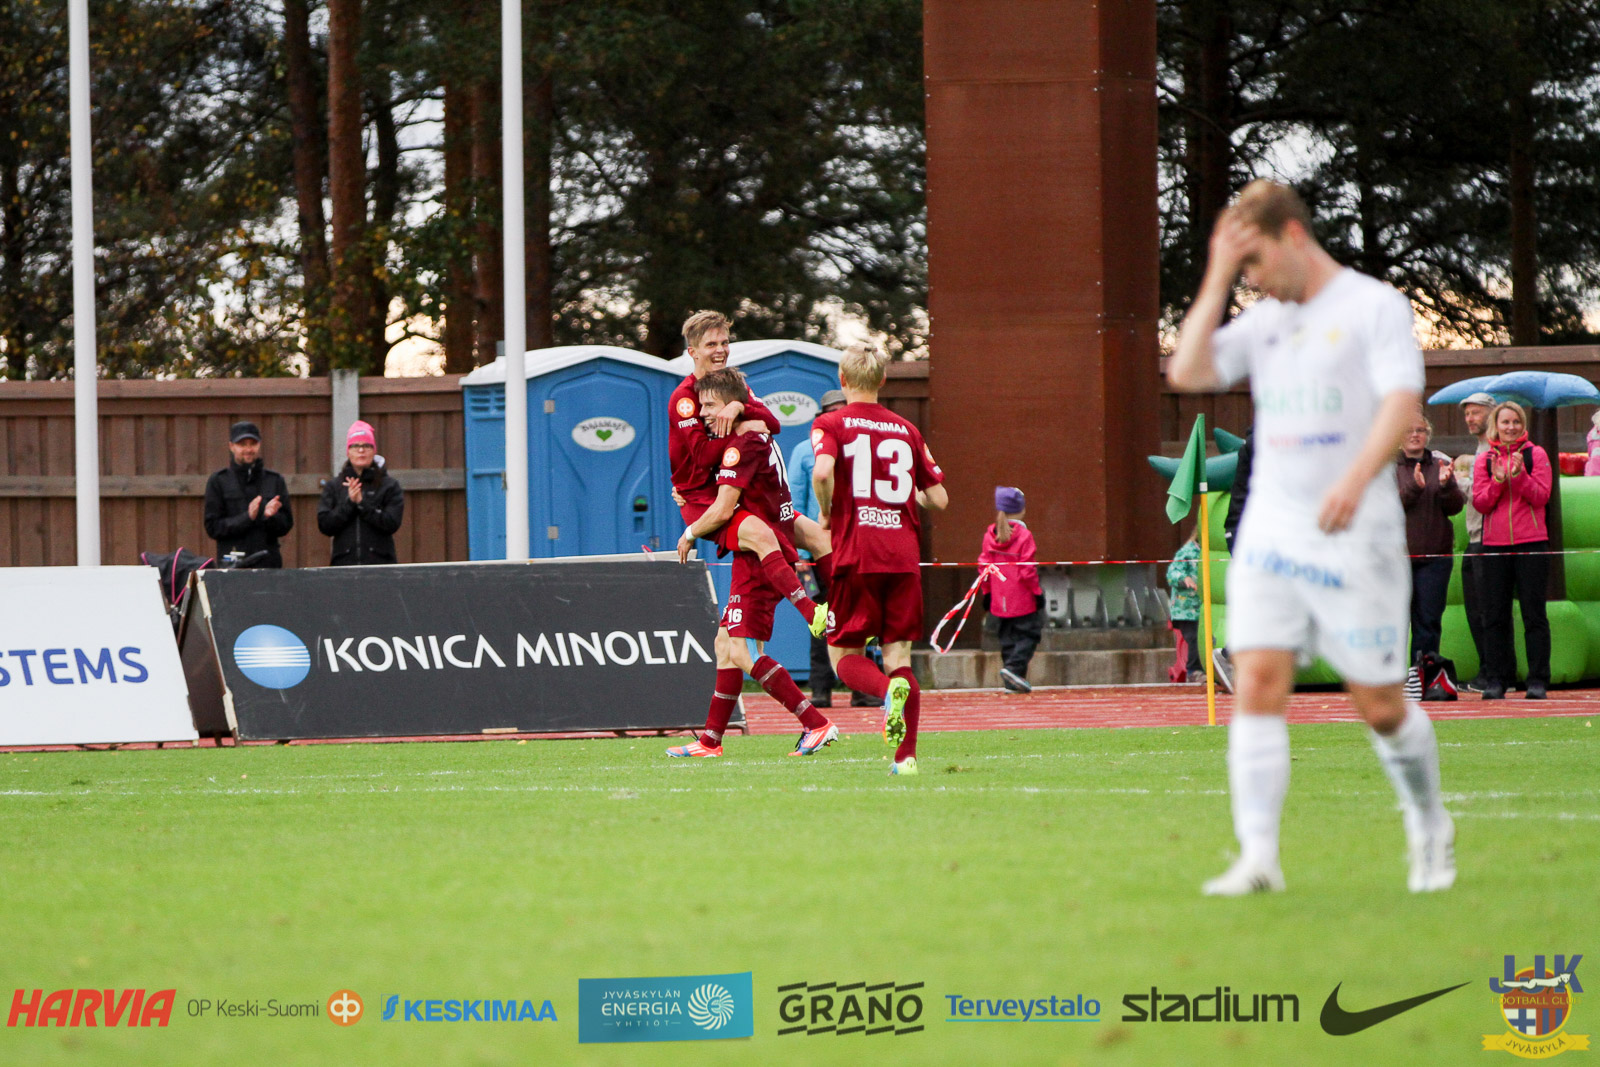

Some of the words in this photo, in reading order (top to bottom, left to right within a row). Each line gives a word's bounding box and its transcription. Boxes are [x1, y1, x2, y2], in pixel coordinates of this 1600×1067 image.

[852, 418, 910, 435] KESKIMAA
[843, 433, 914, 504] 13
[858, 508, 902, 526] GRANO
[727, 608, 743, 623] 16
[323, 633, 507, 673] KONICA
[516, 629, 713, 667] MINOLTA
